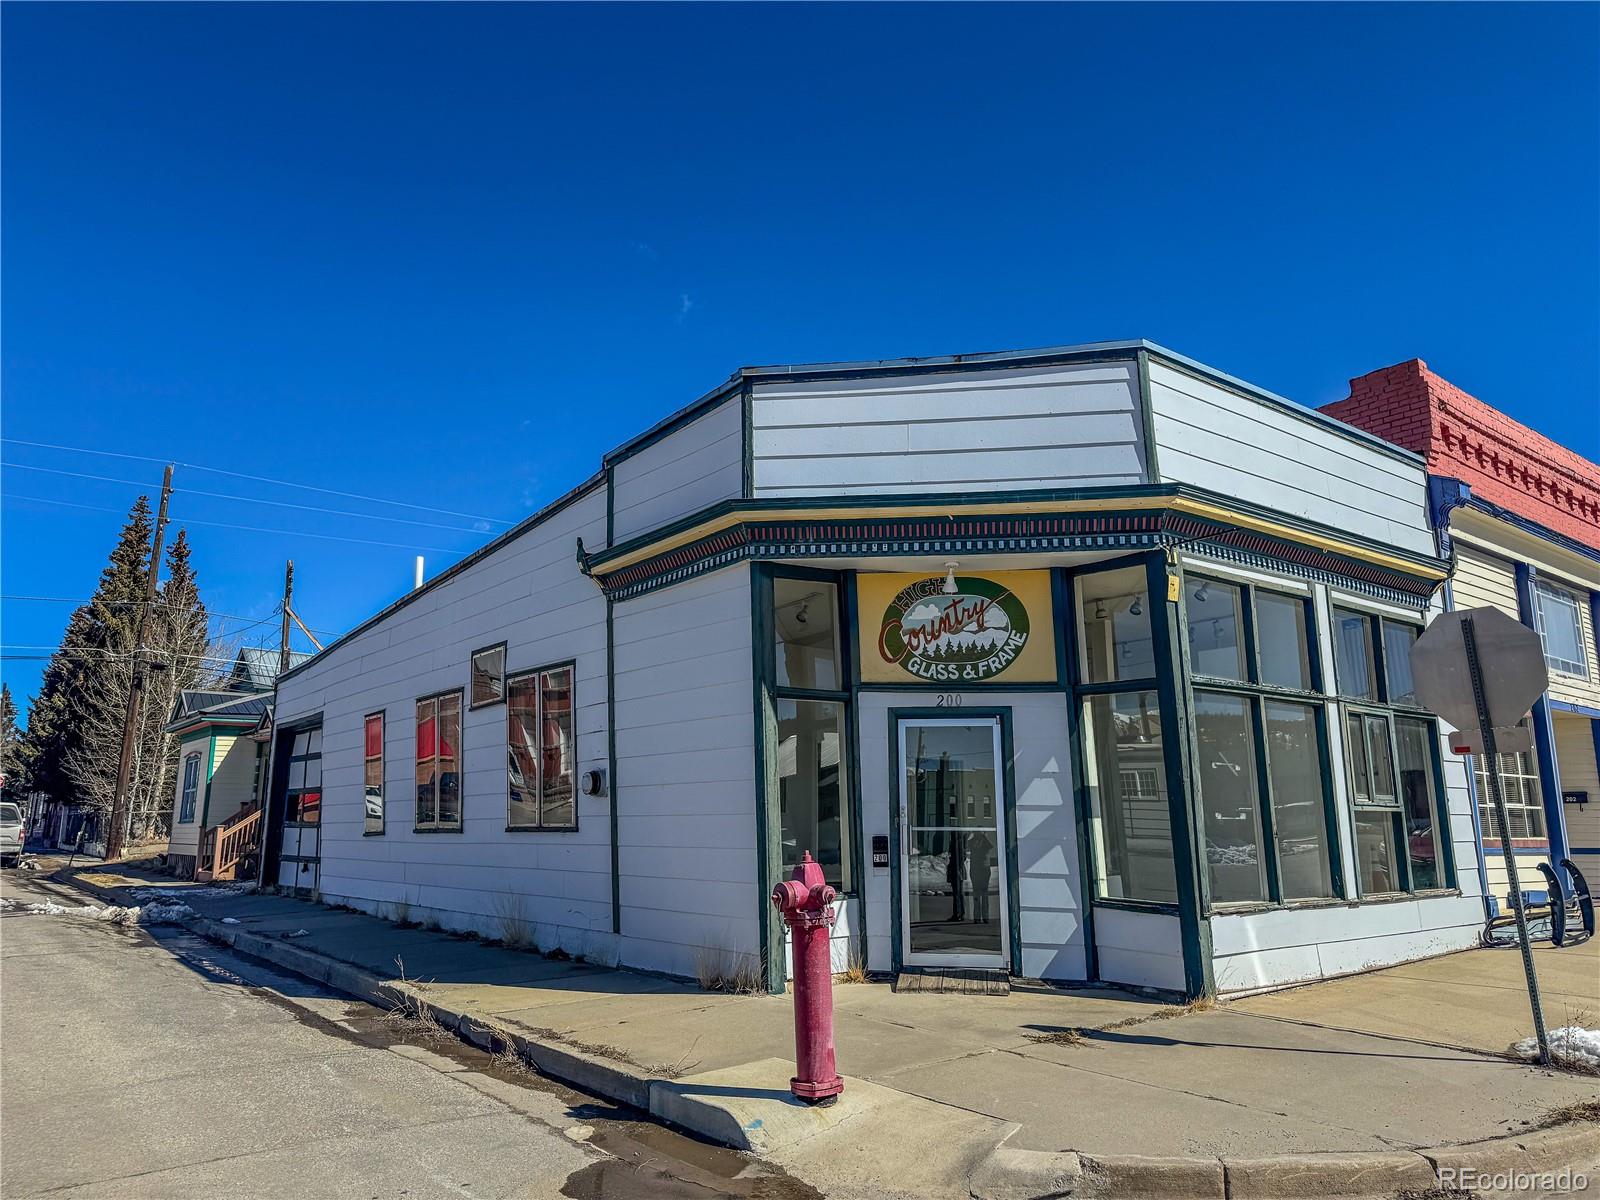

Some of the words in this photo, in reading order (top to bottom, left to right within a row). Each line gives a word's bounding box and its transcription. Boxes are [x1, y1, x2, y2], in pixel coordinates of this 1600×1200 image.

[878, 594, 1000, 664] Country
[907, 657, 959, 680] GLASS
[962, 664, 977, 679] &
[978, 629, 1027, 677] FRAME
[935, 694, 962, 707] 200
